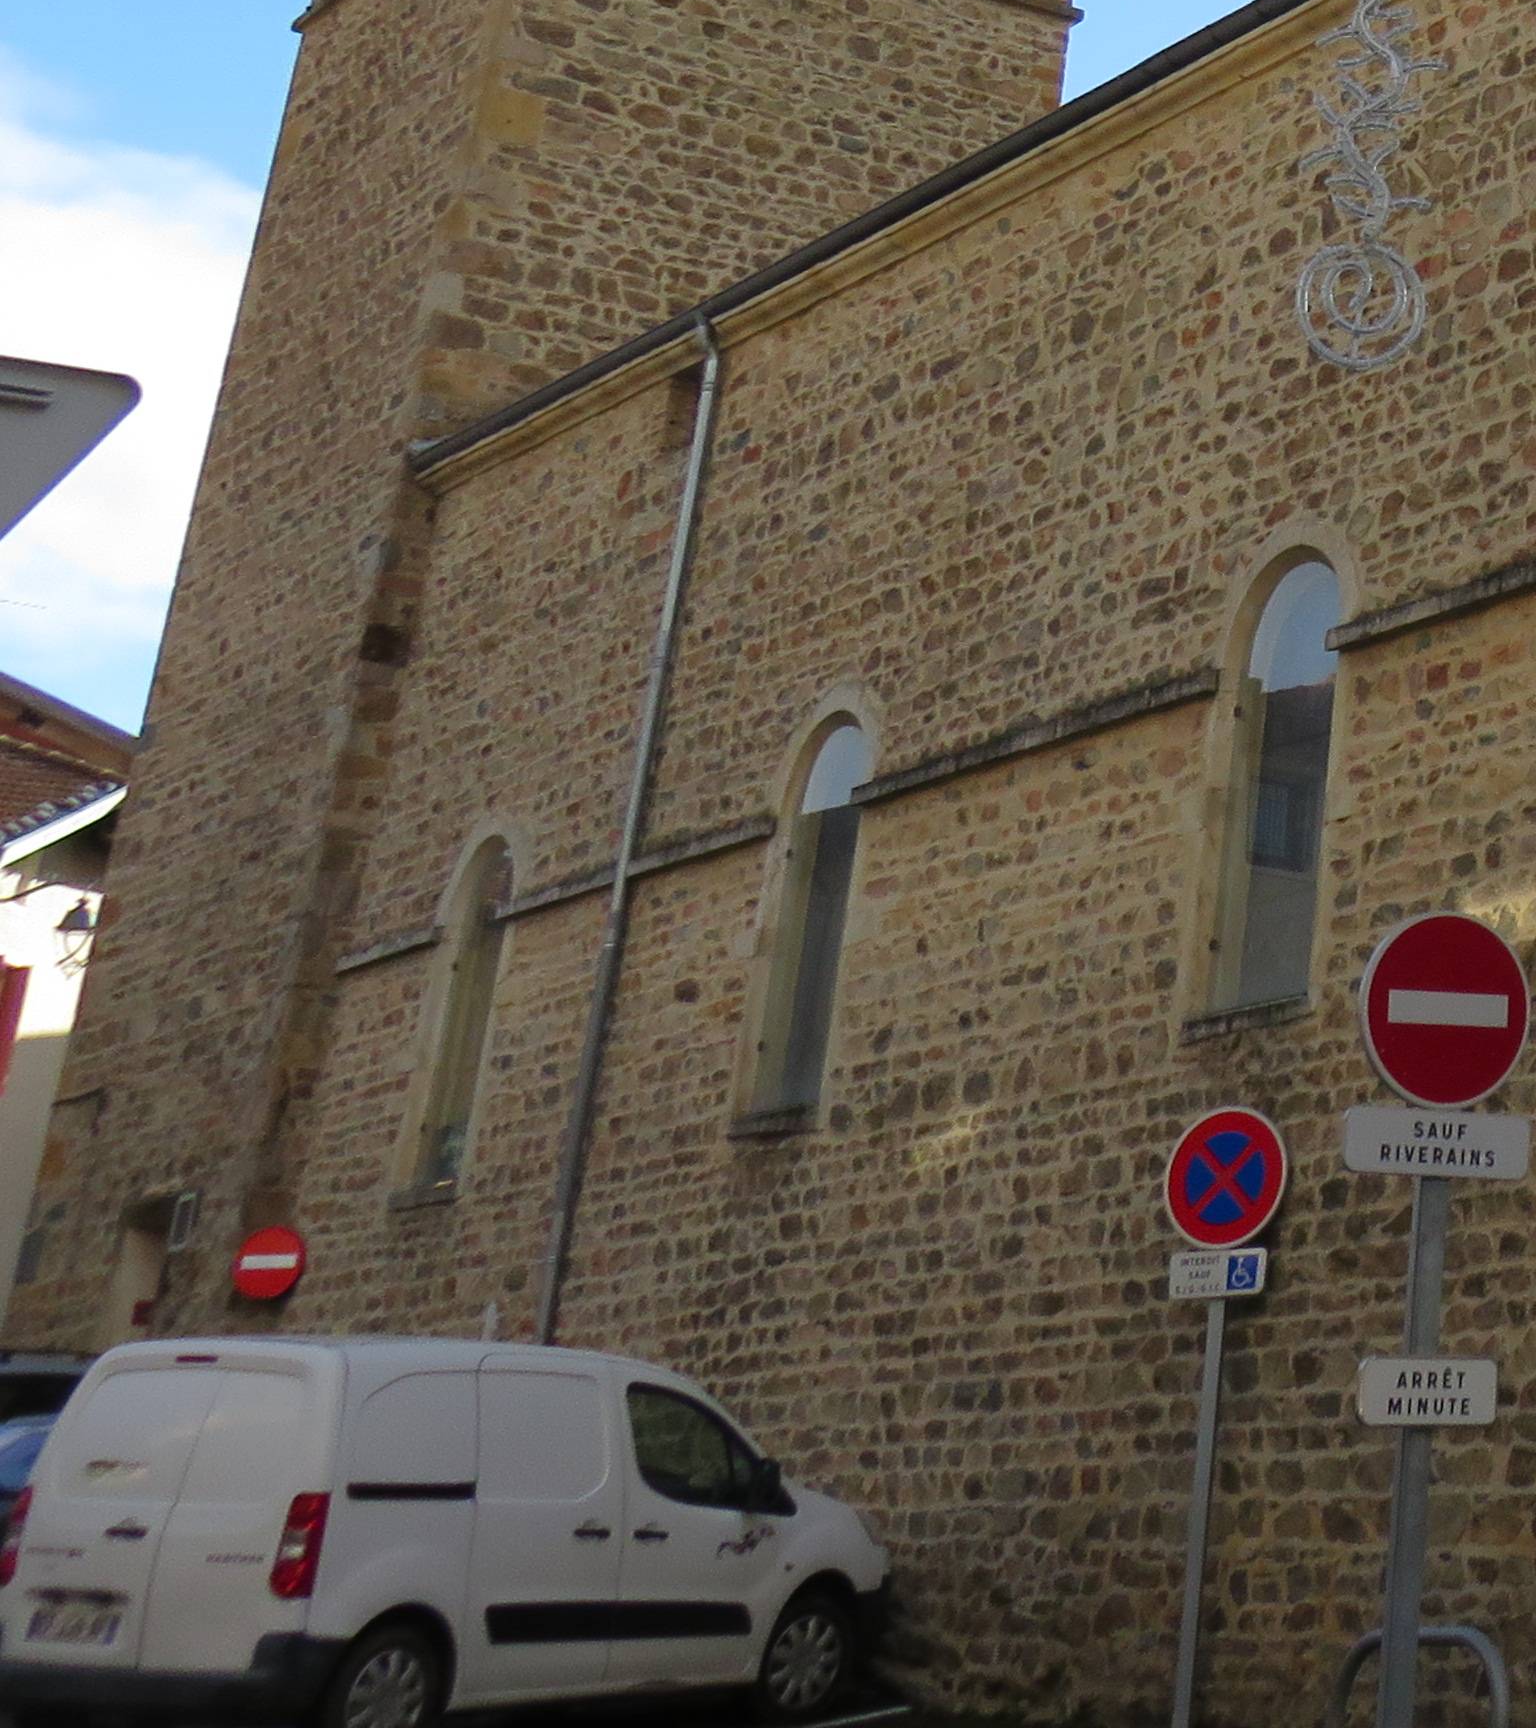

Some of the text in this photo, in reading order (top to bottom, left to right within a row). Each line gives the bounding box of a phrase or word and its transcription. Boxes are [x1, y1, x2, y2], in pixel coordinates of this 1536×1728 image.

[1414, 1120, 1468, 1141] SAUF
[1380, 1143, 1495, 1167] RIVERAINS
[1180, 1255, 1221, 1267] INTERDIT
[1188, 1270, 1211, 1280] SAUF
[1396, 1366, 1466, 1390] ARRÊT
[1387, 1397, 1472, 1416] MINUTE
